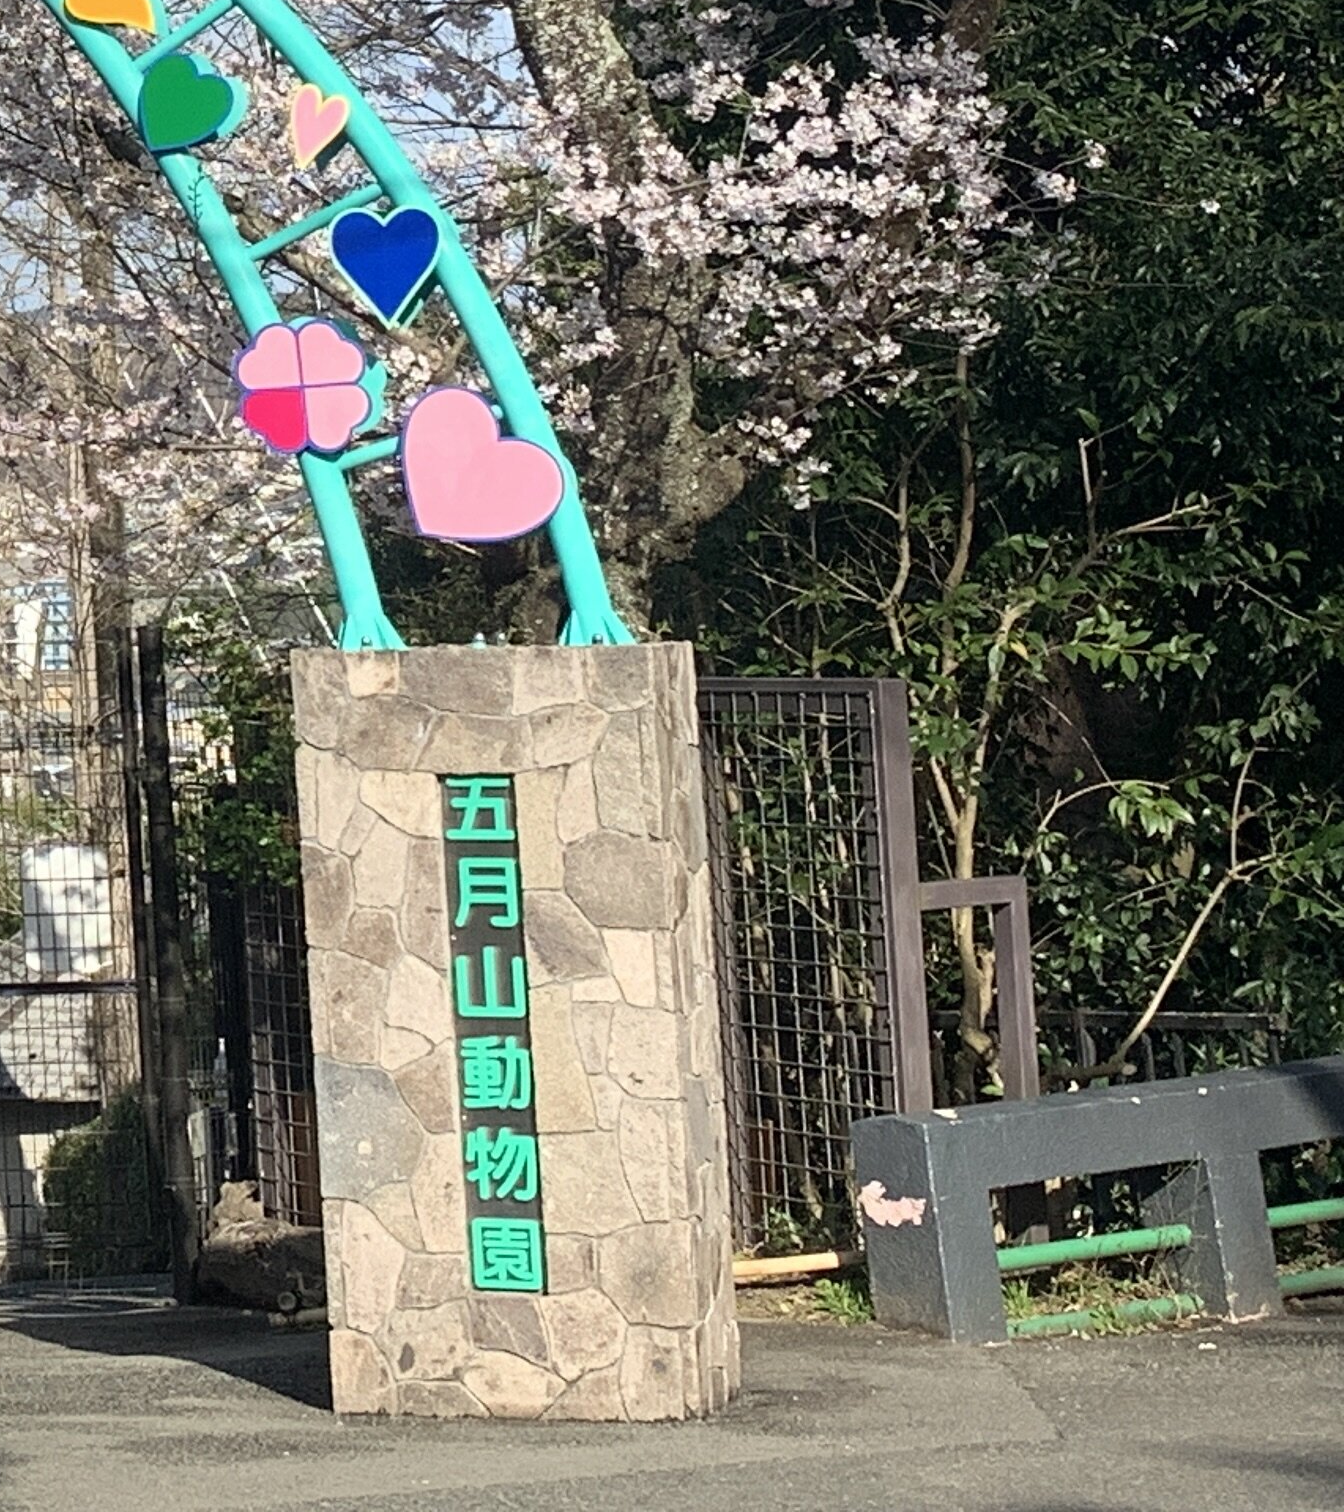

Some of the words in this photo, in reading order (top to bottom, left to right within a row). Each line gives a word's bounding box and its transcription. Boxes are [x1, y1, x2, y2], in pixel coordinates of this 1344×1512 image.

[444, 778, 543, 1291] 五月山動物園
